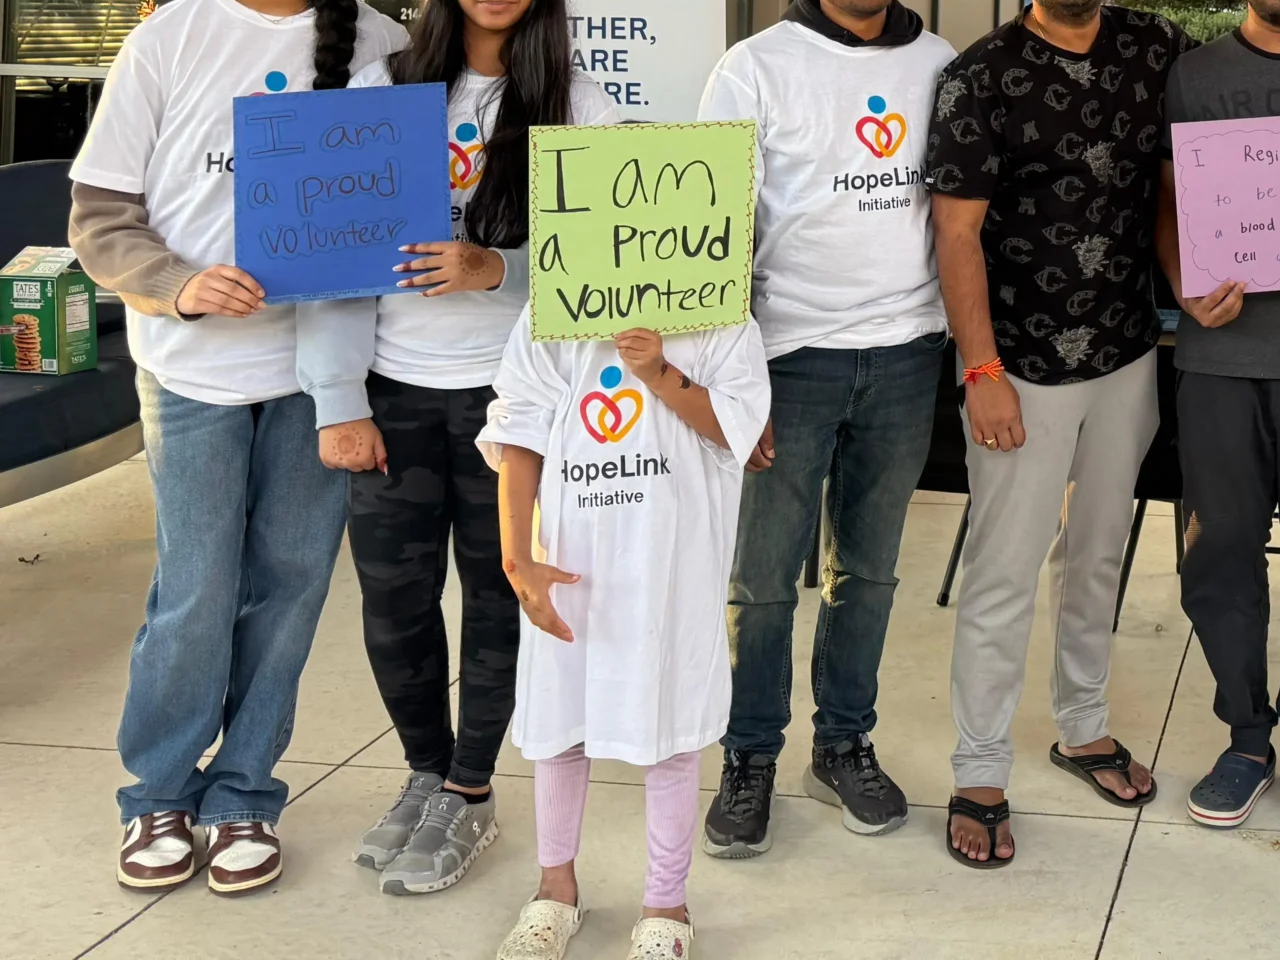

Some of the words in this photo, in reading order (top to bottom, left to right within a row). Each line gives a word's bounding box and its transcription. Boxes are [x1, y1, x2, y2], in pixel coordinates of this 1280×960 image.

[566, 16, 656, 45] THER,
[597, 81, 649, 106] RE.
[249, 114, 303, 155] I
[324, 121, 396, 149] am
[1191, 149, 1206, 168] I
[252, 181, 275, 205] a
[301, 162, 396, 214] proud
[539, 146, 592, 213] I
[612, 158, 716, 208] am
[833, 166, 926, 194] HopeLink
[858, 196, 911, 212] Initiative
[1216, 193, 1231, 207] to
[1257, 187, 1278, 201] be
[1214, 228, 1224, 240] a
[1240, 217, 1275, 235] blood
[538, 232, 569, 275] a
[577, 490, 644, 508] Initiative
